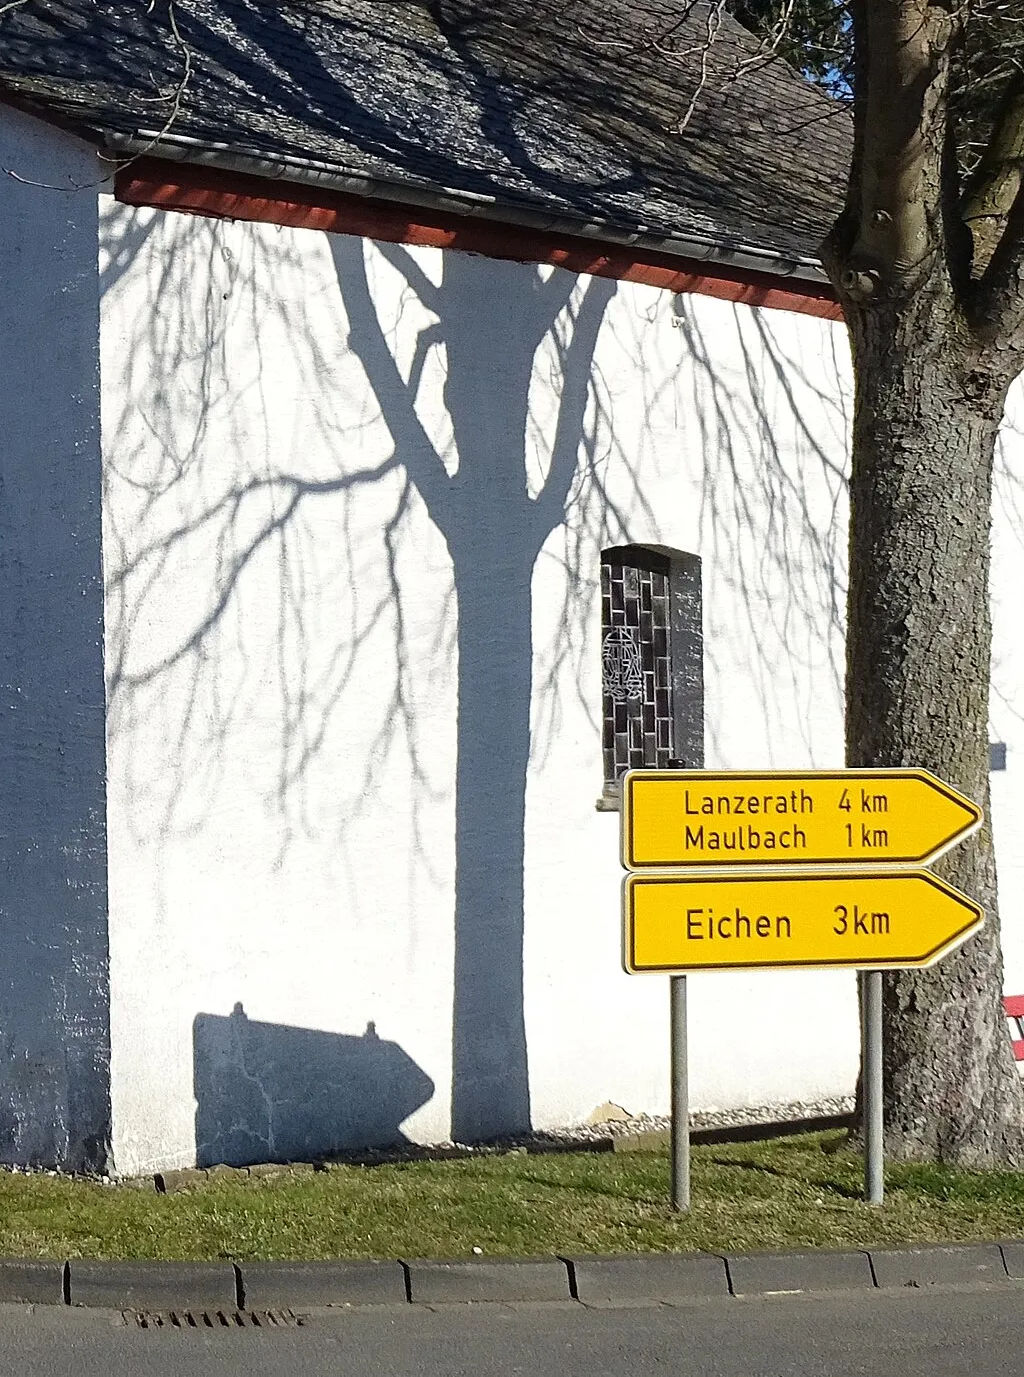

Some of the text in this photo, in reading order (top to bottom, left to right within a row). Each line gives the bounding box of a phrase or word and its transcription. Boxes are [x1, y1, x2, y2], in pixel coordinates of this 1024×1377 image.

[685, 788, 889, 815] Lanzerath 4 km
[685, 823, 888, 851] Maulbach 1 km
[686, 907, 792, 941] Eichen
